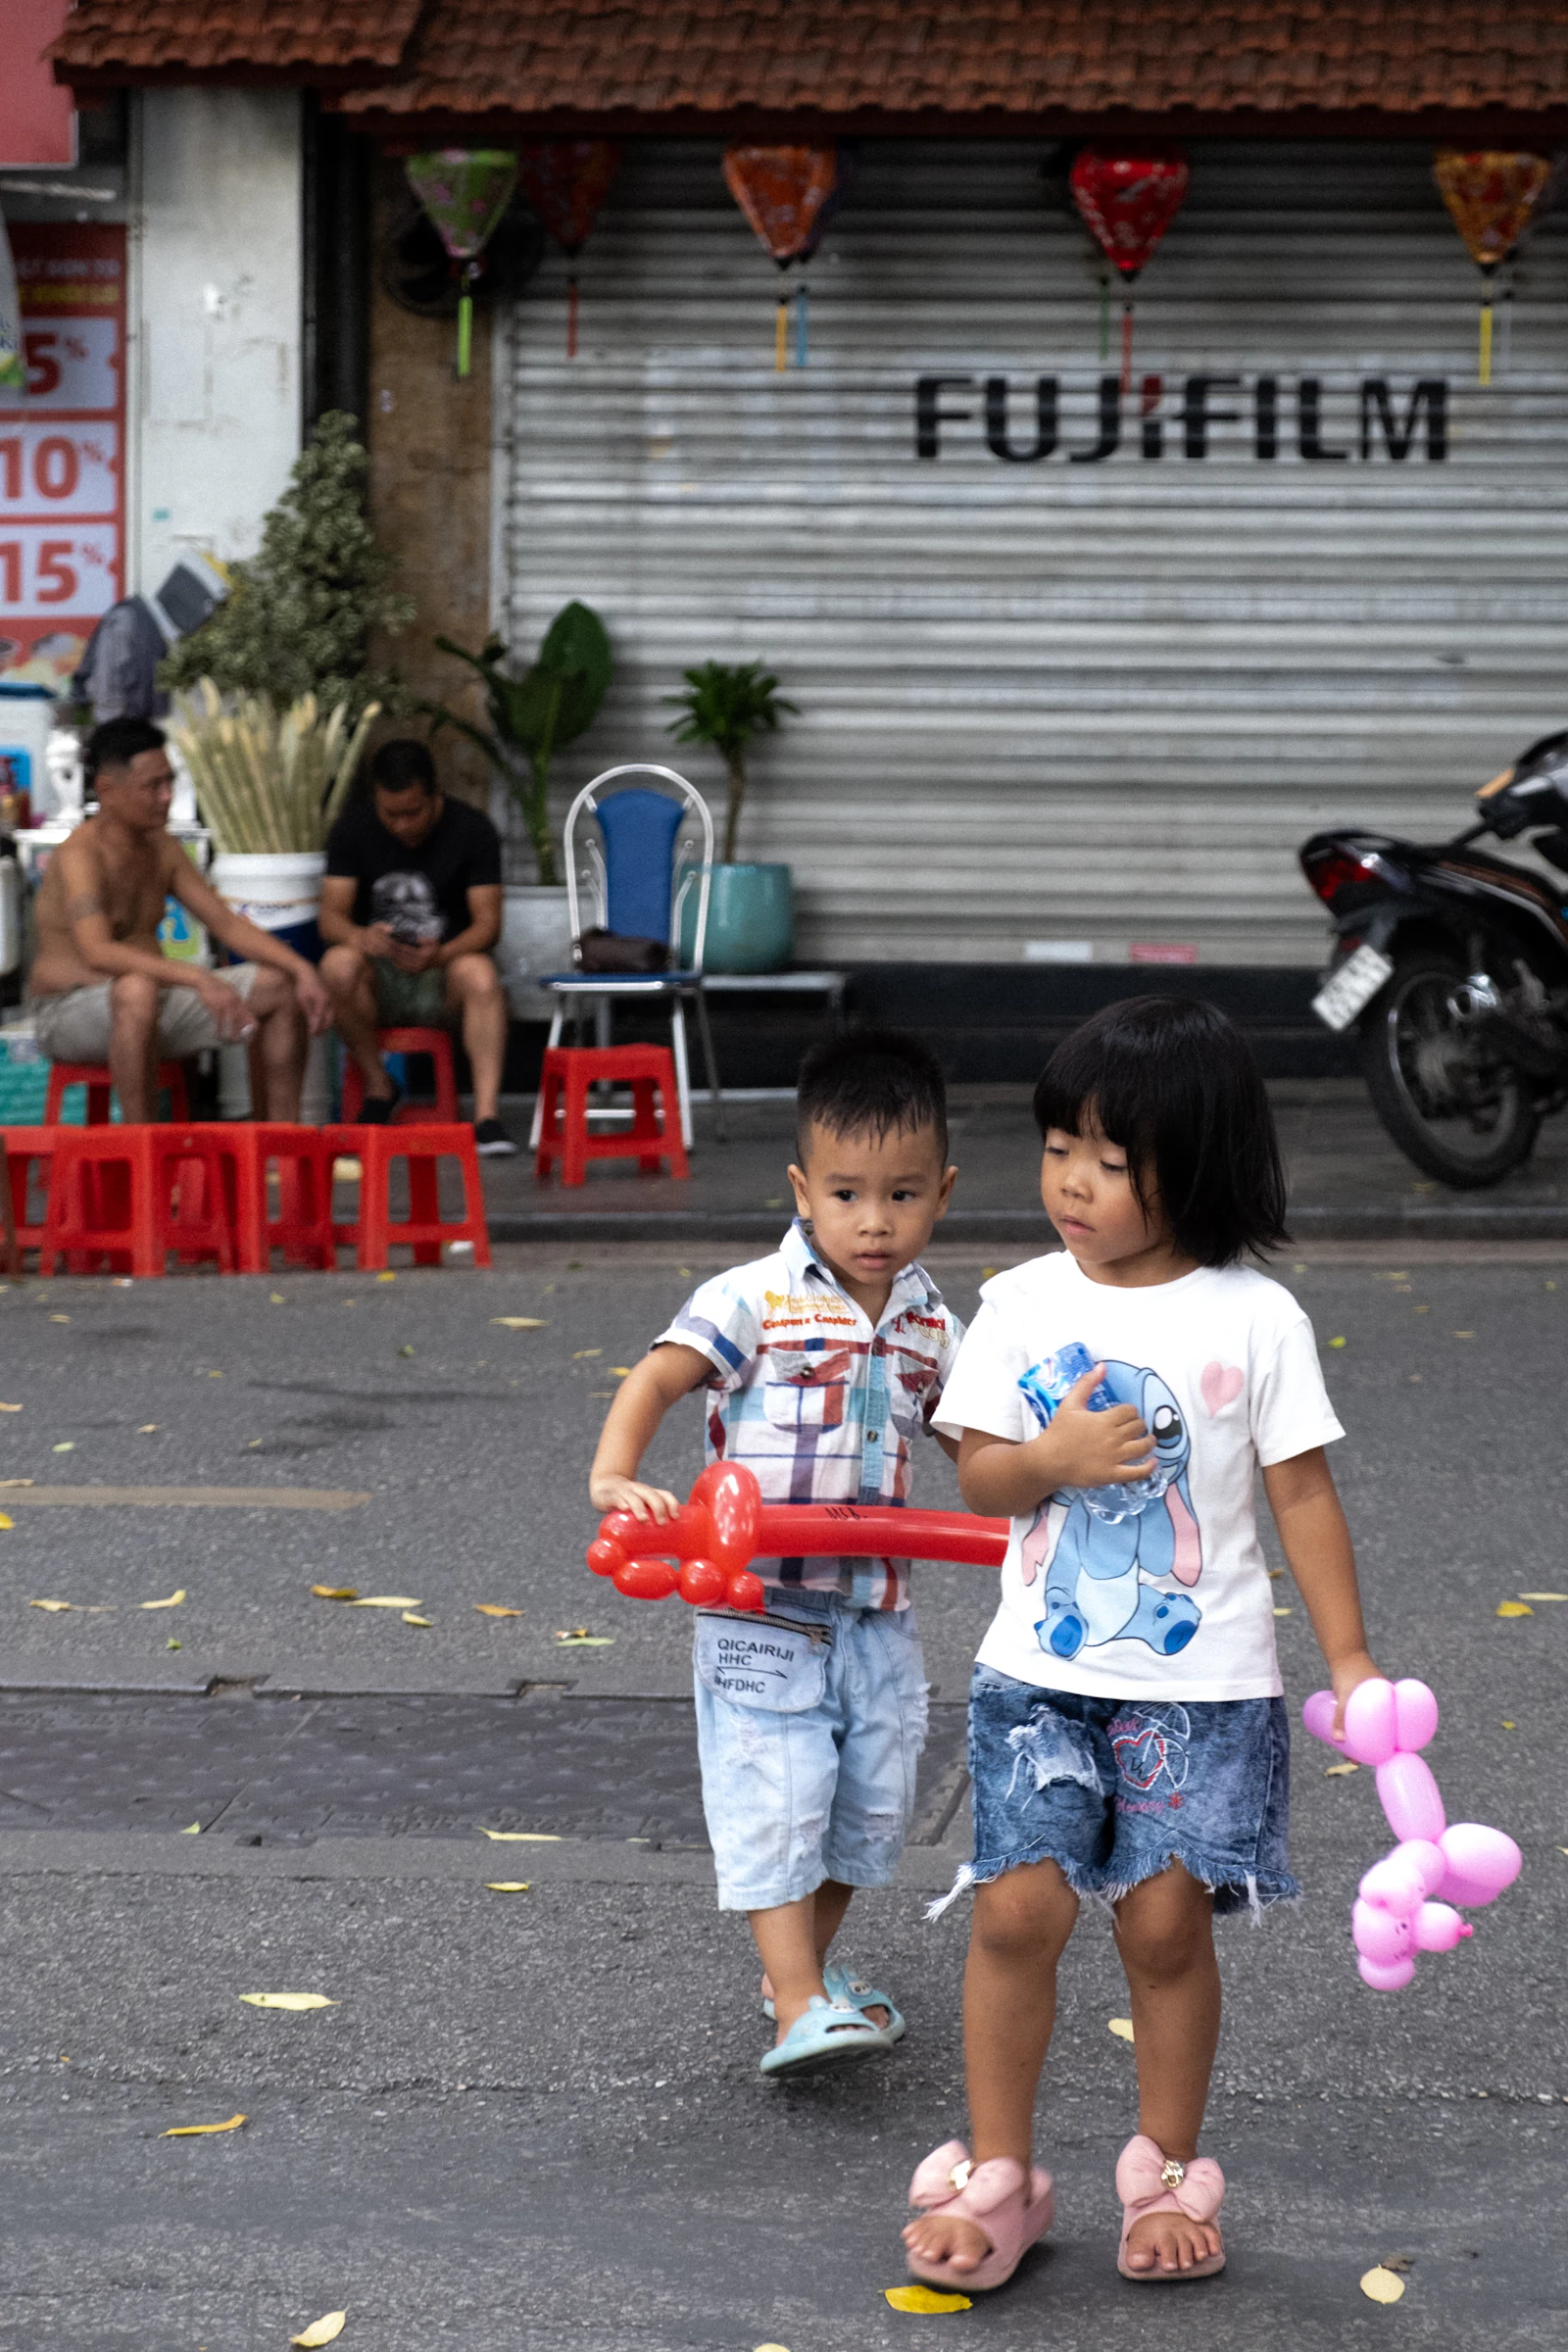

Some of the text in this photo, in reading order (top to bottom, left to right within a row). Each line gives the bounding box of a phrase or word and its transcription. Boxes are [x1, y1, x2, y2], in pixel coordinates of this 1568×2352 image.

[916, 376, 1447, 462] FUJIFILM
[0, 436, 105, 500] 10%
[0, 541, 105, 604] 15%
[718, 1652, 753, 1666] HHC
